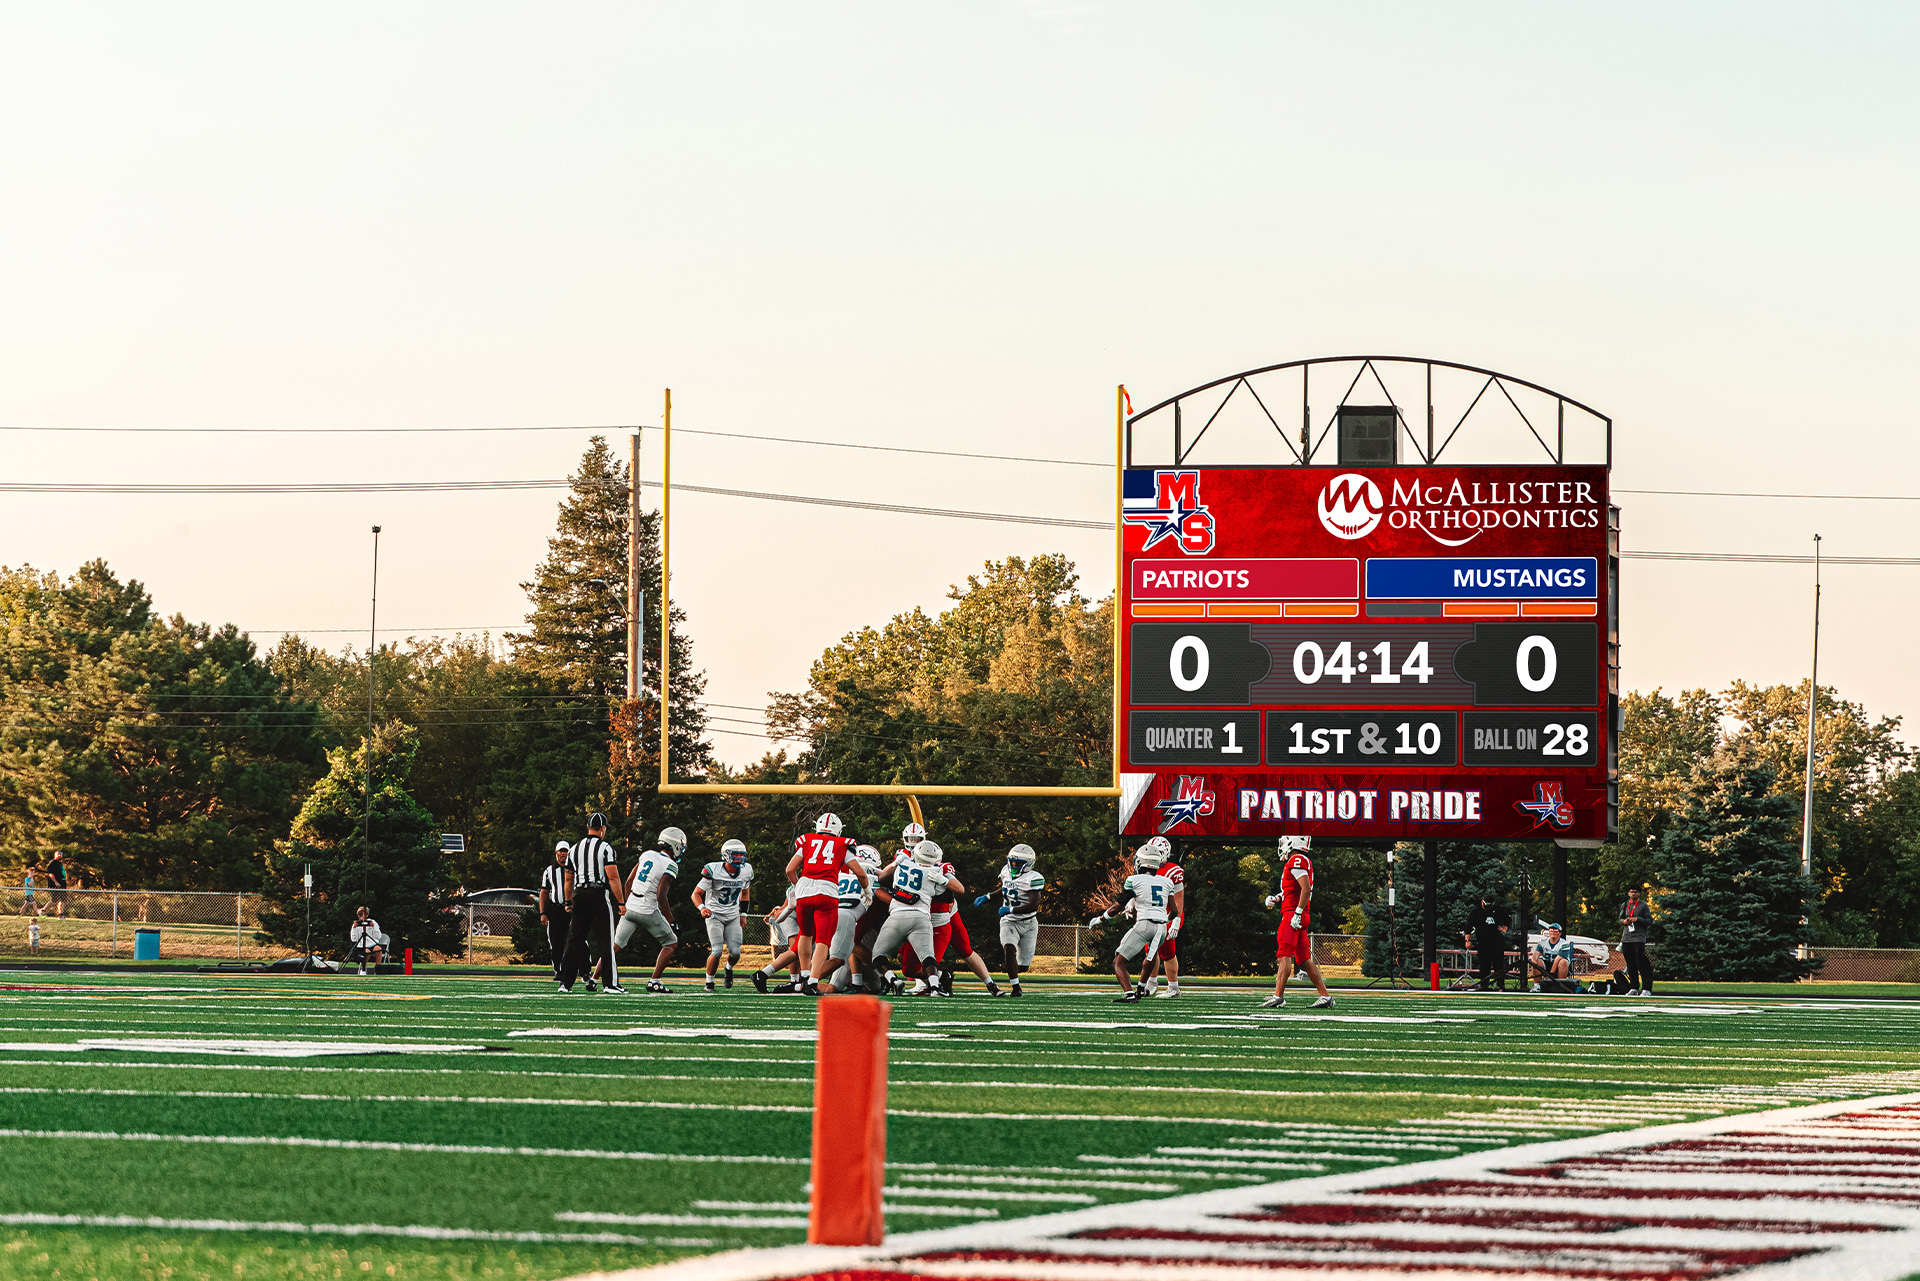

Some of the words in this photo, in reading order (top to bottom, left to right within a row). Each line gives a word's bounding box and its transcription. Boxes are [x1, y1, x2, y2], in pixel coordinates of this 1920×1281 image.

[1388, 509, 1599, 533] ORTHODONTICS
[1142, 569, 1250, 589] PATRIOTS
[1453, 568, 1586, 588] MUSTANGS
[1169, 635, 1210, 692] 0
[1292, 640, 1434, 685] 04:14
[1515, 634, 1557, 692] 0
[1145, 727, 1214, 751] QUARTER
[1221, 722, 1243, 754] 1
[1288, 722, 1352, 755] 1ST
[1357, 722, 1388, 755] &
[1394, 722, 1441, 755] 10
[1474, 728, 1512, 750] BALL
[1516, 728, 1537, 751] ON
[1542, 723, 1589, 756] 28
[1239, 789, 1379, 821] PATRIOT
[1390, 790, 1481, 821] PRIDE
[808, 839, 835, 865] 74
[1293, 857, 1302, 868] 2
[638, 860, 653, 882] 2
[897, 864, 923, 891] 53
[1174, 871, 1184, 883] 75
[718, 887, 743, 906] 34
[1151, 885, 1163, 907] 5
